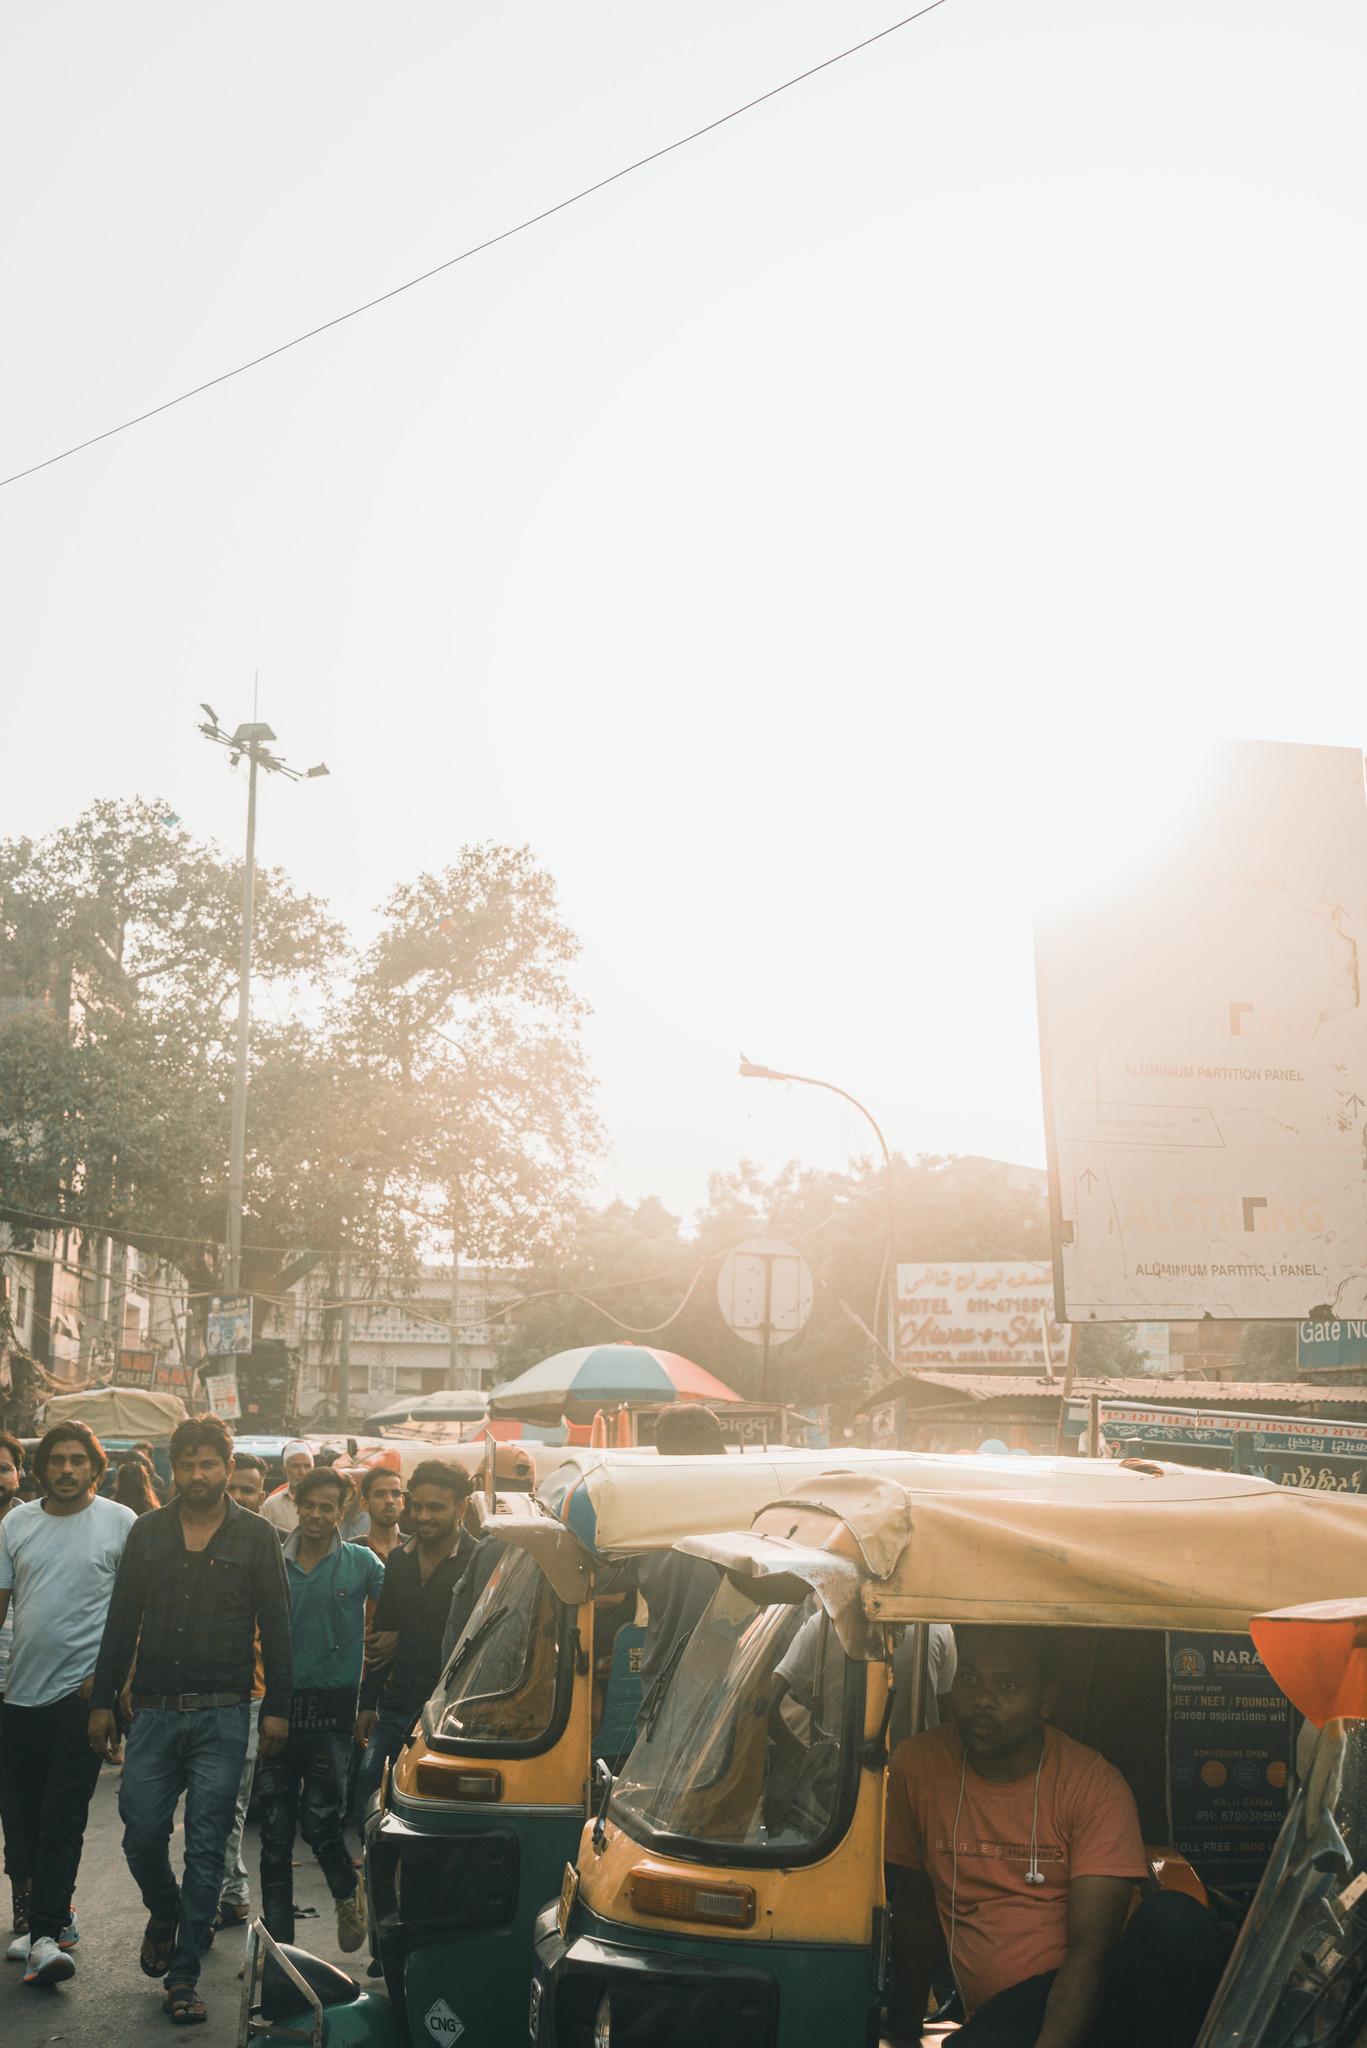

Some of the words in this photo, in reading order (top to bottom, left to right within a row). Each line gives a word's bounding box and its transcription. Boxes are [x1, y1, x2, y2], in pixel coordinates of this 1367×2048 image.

[1124, 1063, 1194, 1078] ALUMINIUM
[1197, 1066, 1261, 1081] PARTITION
[1263, 1068, 1305, 1082] PANEL
[1135, 1262, 1207, 1277] ALUMINIUM
[1279, 1264, 1321, 1277] PANEL
[895, 1297, 952, 1315] HOTEL
[1299, 1320, 1342, 1344] Gate
[1173, 1695, 1191, 1706] JEE
[1200, 1695, 1226, 1707] NEET
[1174, 1711, 1206, 1720] career
[1209, 1710, 1266, 1722] aspirations
[1245, 1750, 1268, 1759] OPEN
[1196, 1810, 1217, 1822] PH:
[1203, 1842, 1232, 1852] FREE
[430, 2016, 456, 2032] CNG
